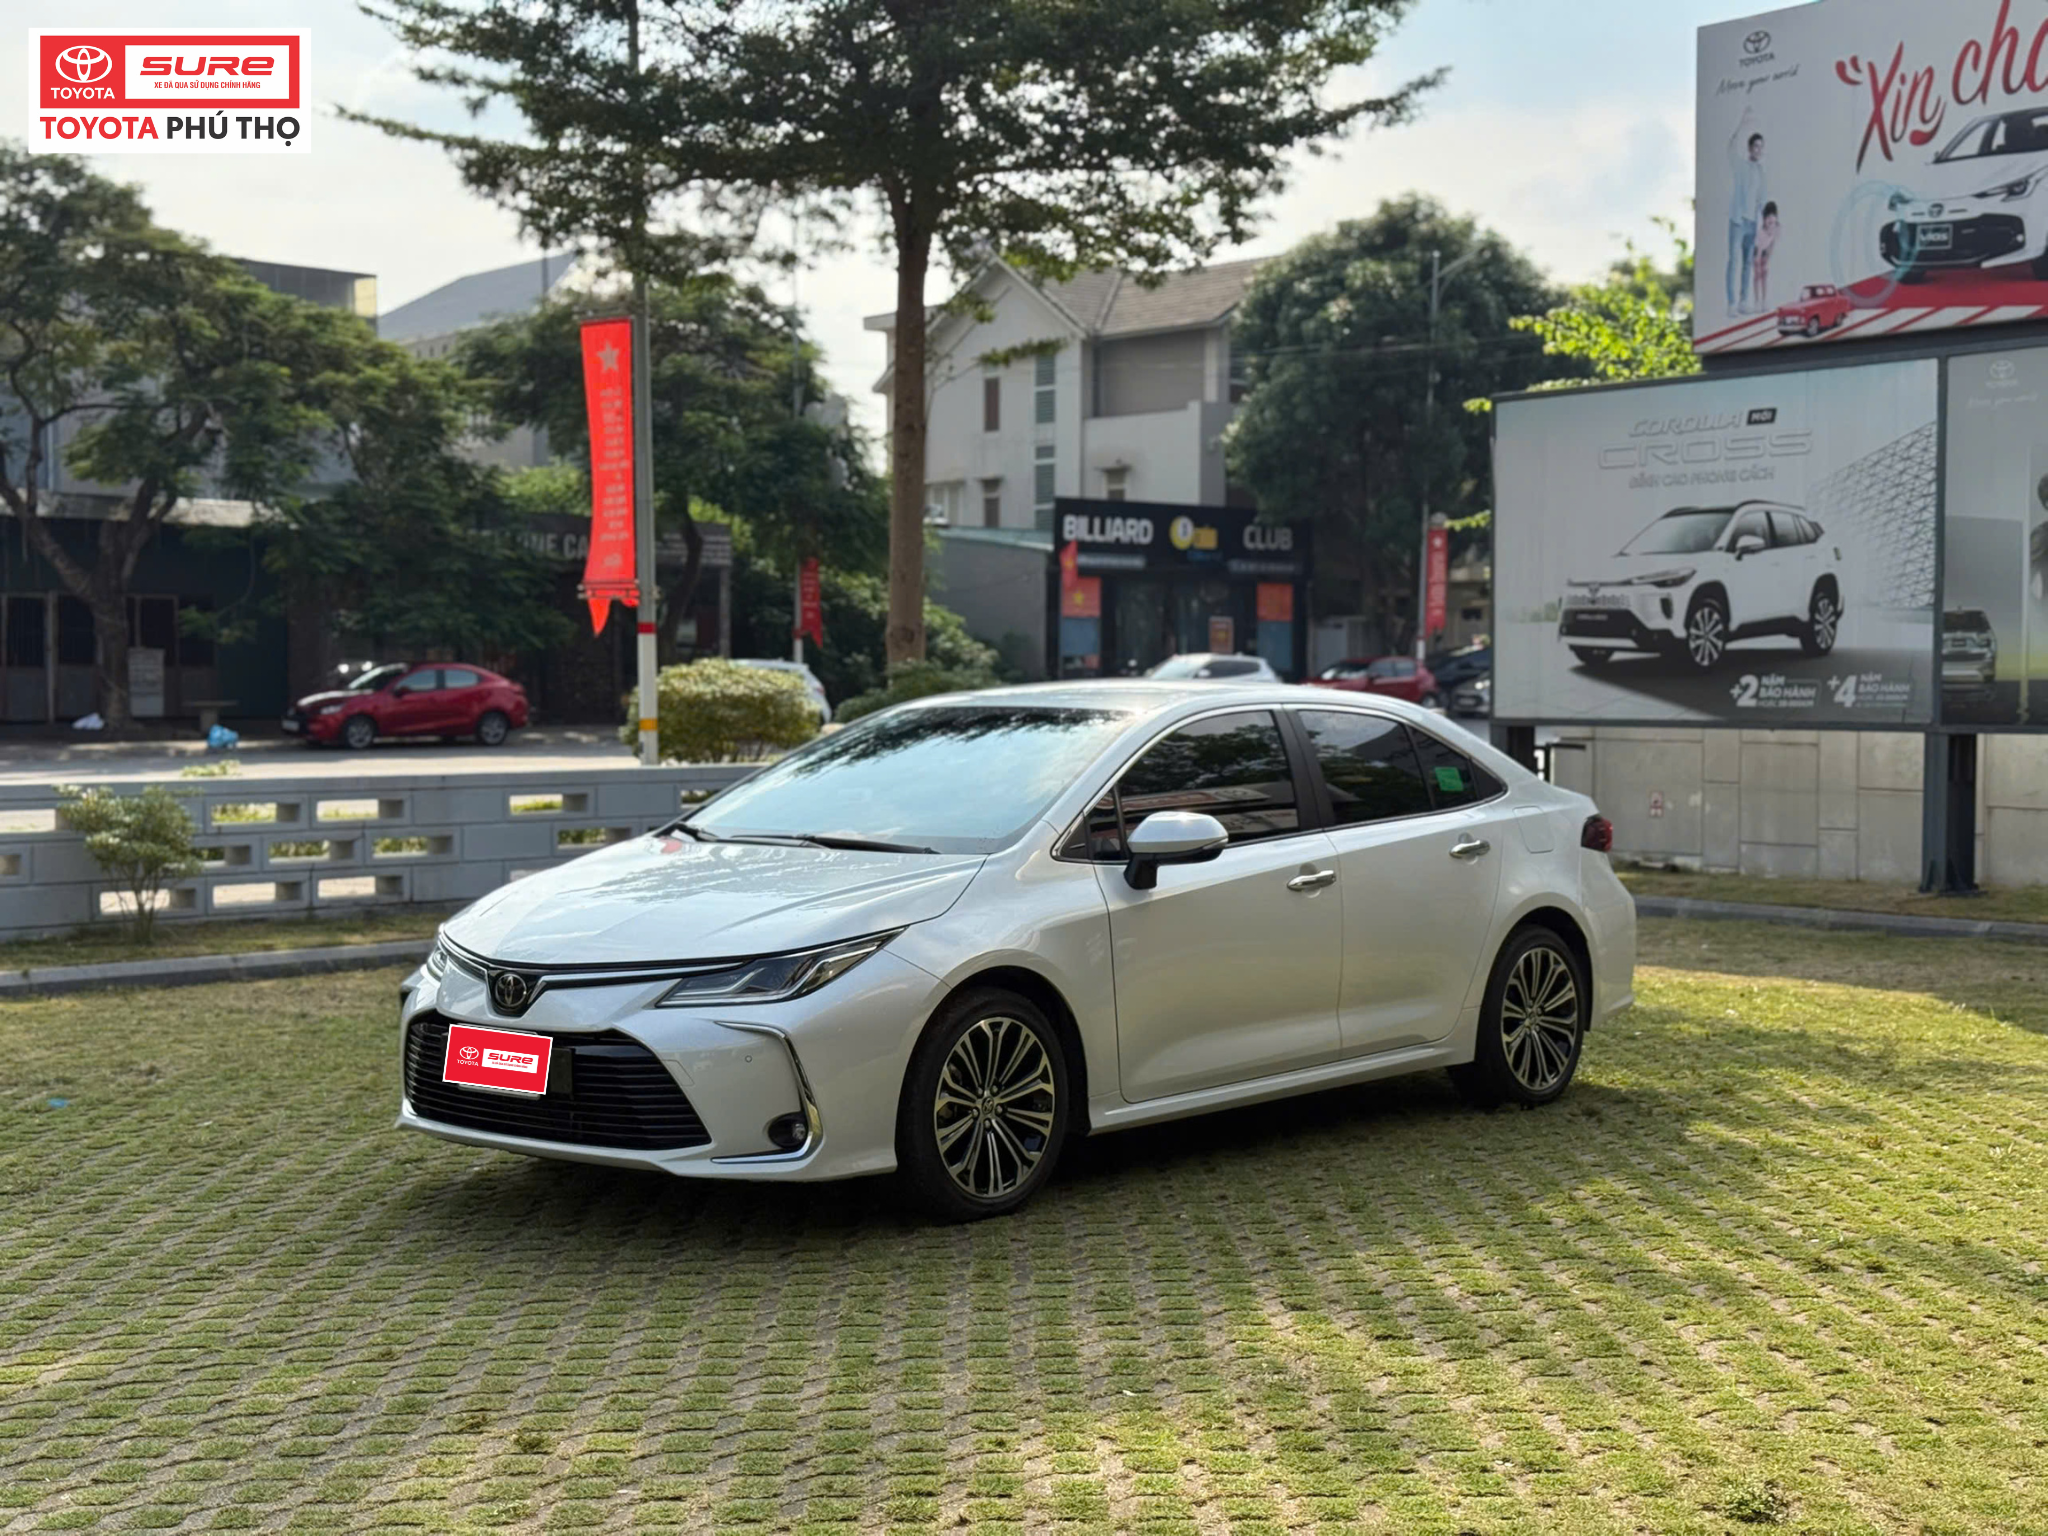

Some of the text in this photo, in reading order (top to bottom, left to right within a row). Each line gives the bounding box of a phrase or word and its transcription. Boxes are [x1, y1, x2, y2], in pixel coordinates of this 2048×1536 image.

[1598, 429, 1813, 470] CROSS
[1063, 514, 1154, 545] BILLIARD
[1243, 525, 1293, 550] CLUB
[1730, 674, 1759, 707] +2
[1827, 674, 1857, 708] +4
